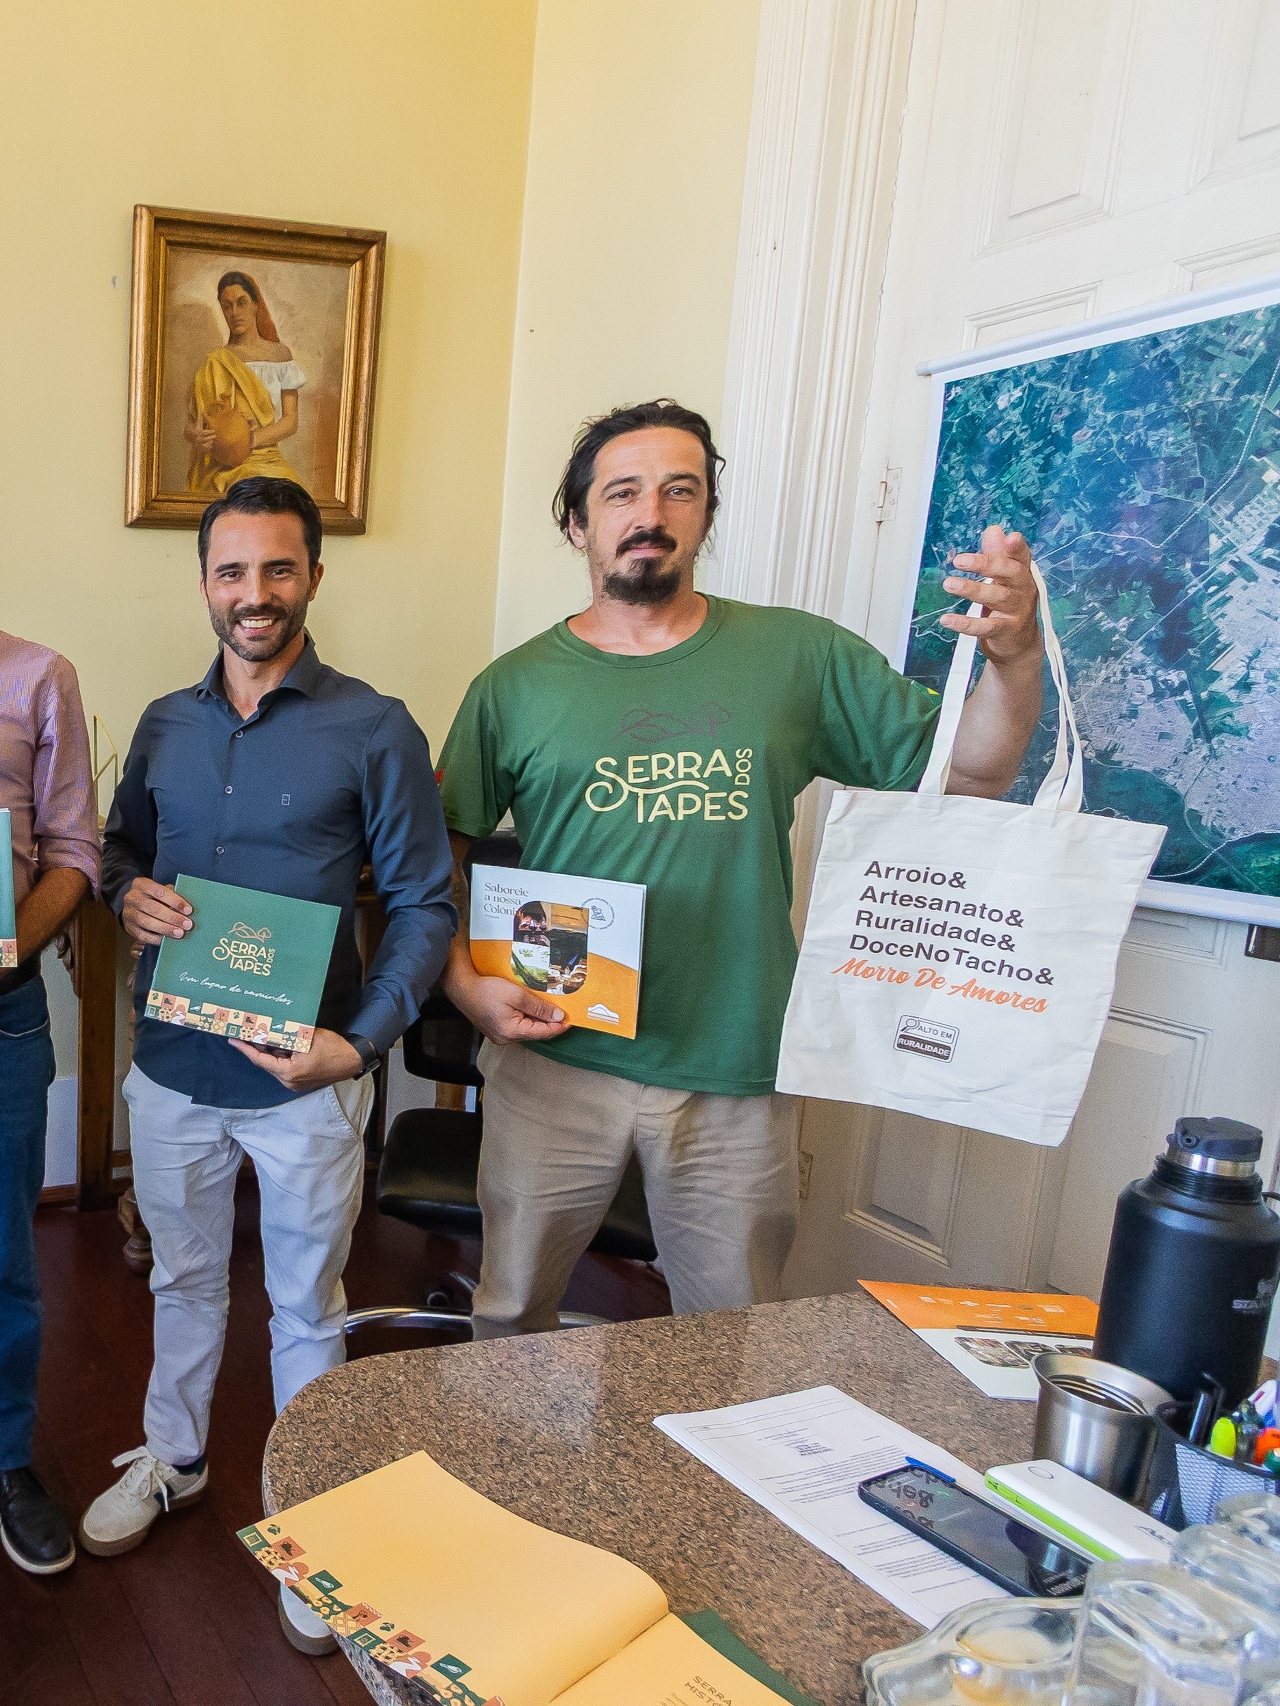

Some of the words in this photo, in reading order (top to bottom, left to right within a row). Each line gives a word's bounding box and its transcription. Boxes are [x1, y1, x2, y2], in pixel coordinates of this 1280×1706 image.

[585, 748, 733, 812] SERRA
[734, 747, 753, 786] DOS
[637, 790, 749, 823] TAPES
[484, 881, 529, 898] Saboreie
[863, 860, 967, 890] Arroio&
[483, 903, 518, 916] Coloni
[493, 895, 522, 906] nossa
[858, 885, 1025, 929] Artesanato&
[854, 909, 1016, 953] Ruralidade&
[212, 937, 267, 961] SERRA
[266, 947, 276, 963] DOS
[848, 933, 1055, 986] DoceNoTacho&
[229, 956, 272, 976] TAPES
[200, 977, 227, 989] lugar
[228, 984, 242, 993] de
[243, 988, 295, 1006] caminhos
[830, 956, 912, 985] Morro
[913, 967, 948, 990] De
[946, 977, 1049, 1014] Amores
[897, 1036, 951, 1057] RURALIDADE
[917, 1025, 939, 1037] ALTO
[940, 1030, 953, 1040] EM
[692, 1675, 732, 1706] SERRA
